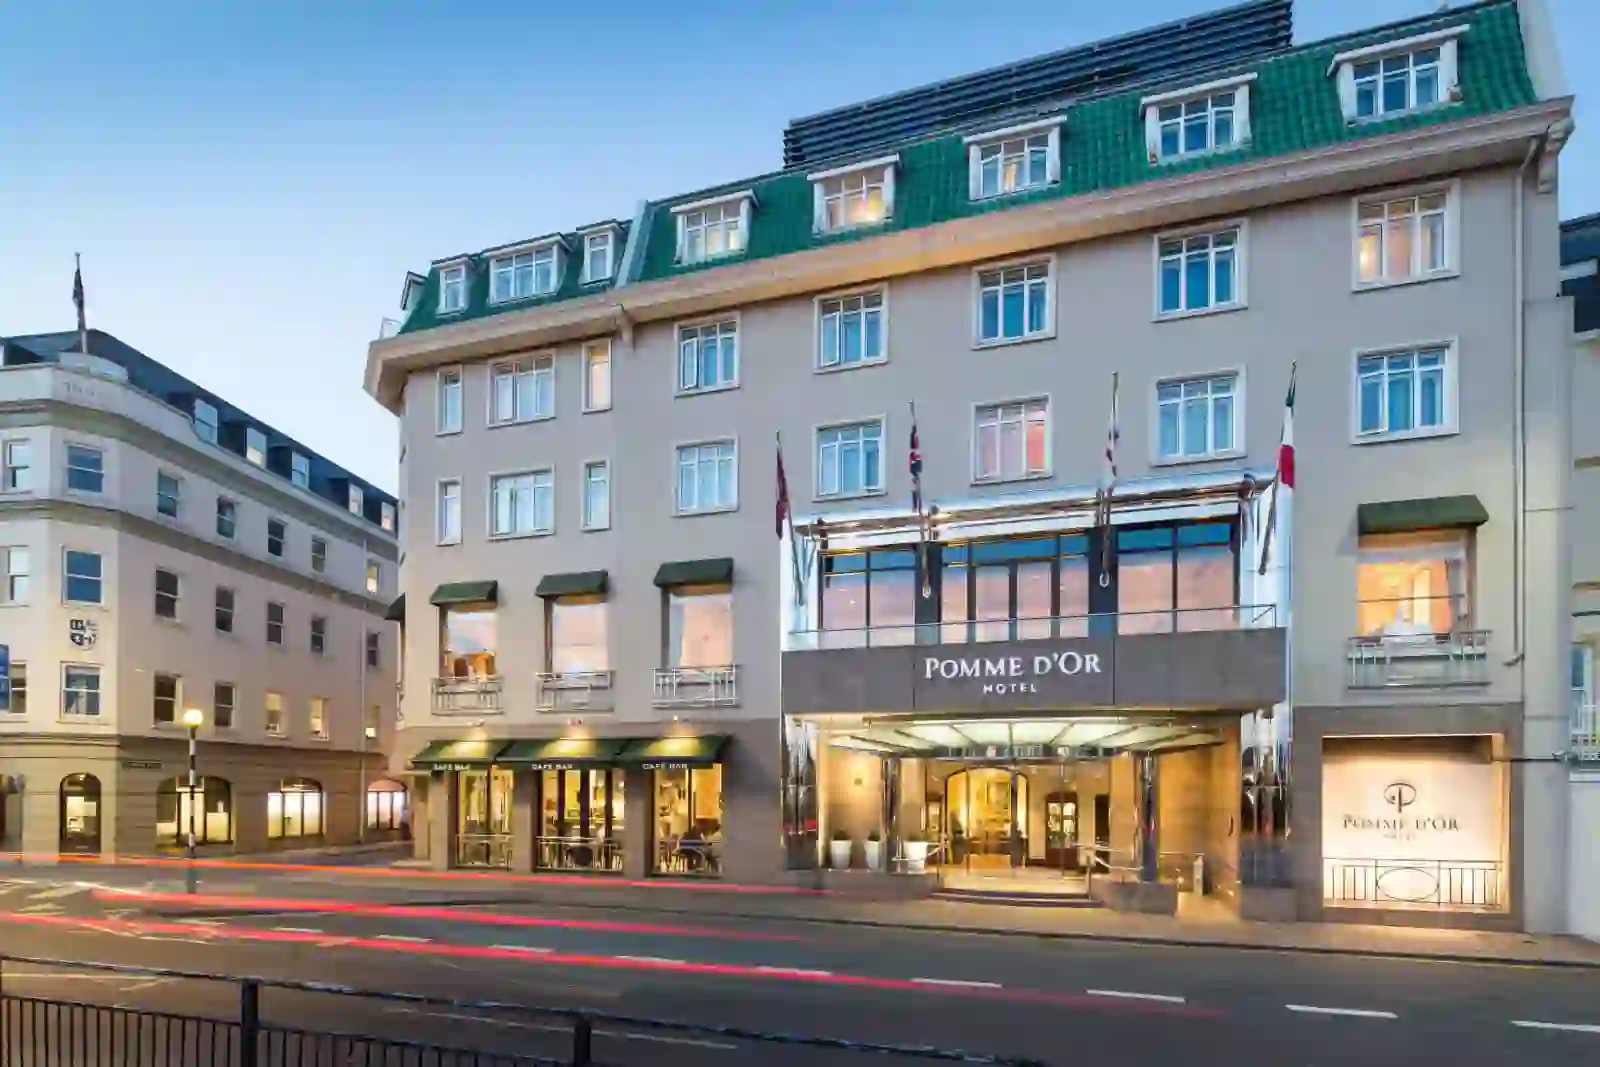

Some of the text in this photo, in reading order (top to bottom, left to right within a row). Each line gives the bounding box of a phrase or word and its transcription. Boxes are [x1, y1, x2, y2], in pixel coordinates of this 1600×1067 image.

[924, 651, 1102, 679] POMME D'OR
[983, 683, 1037, 694] HOTEL
